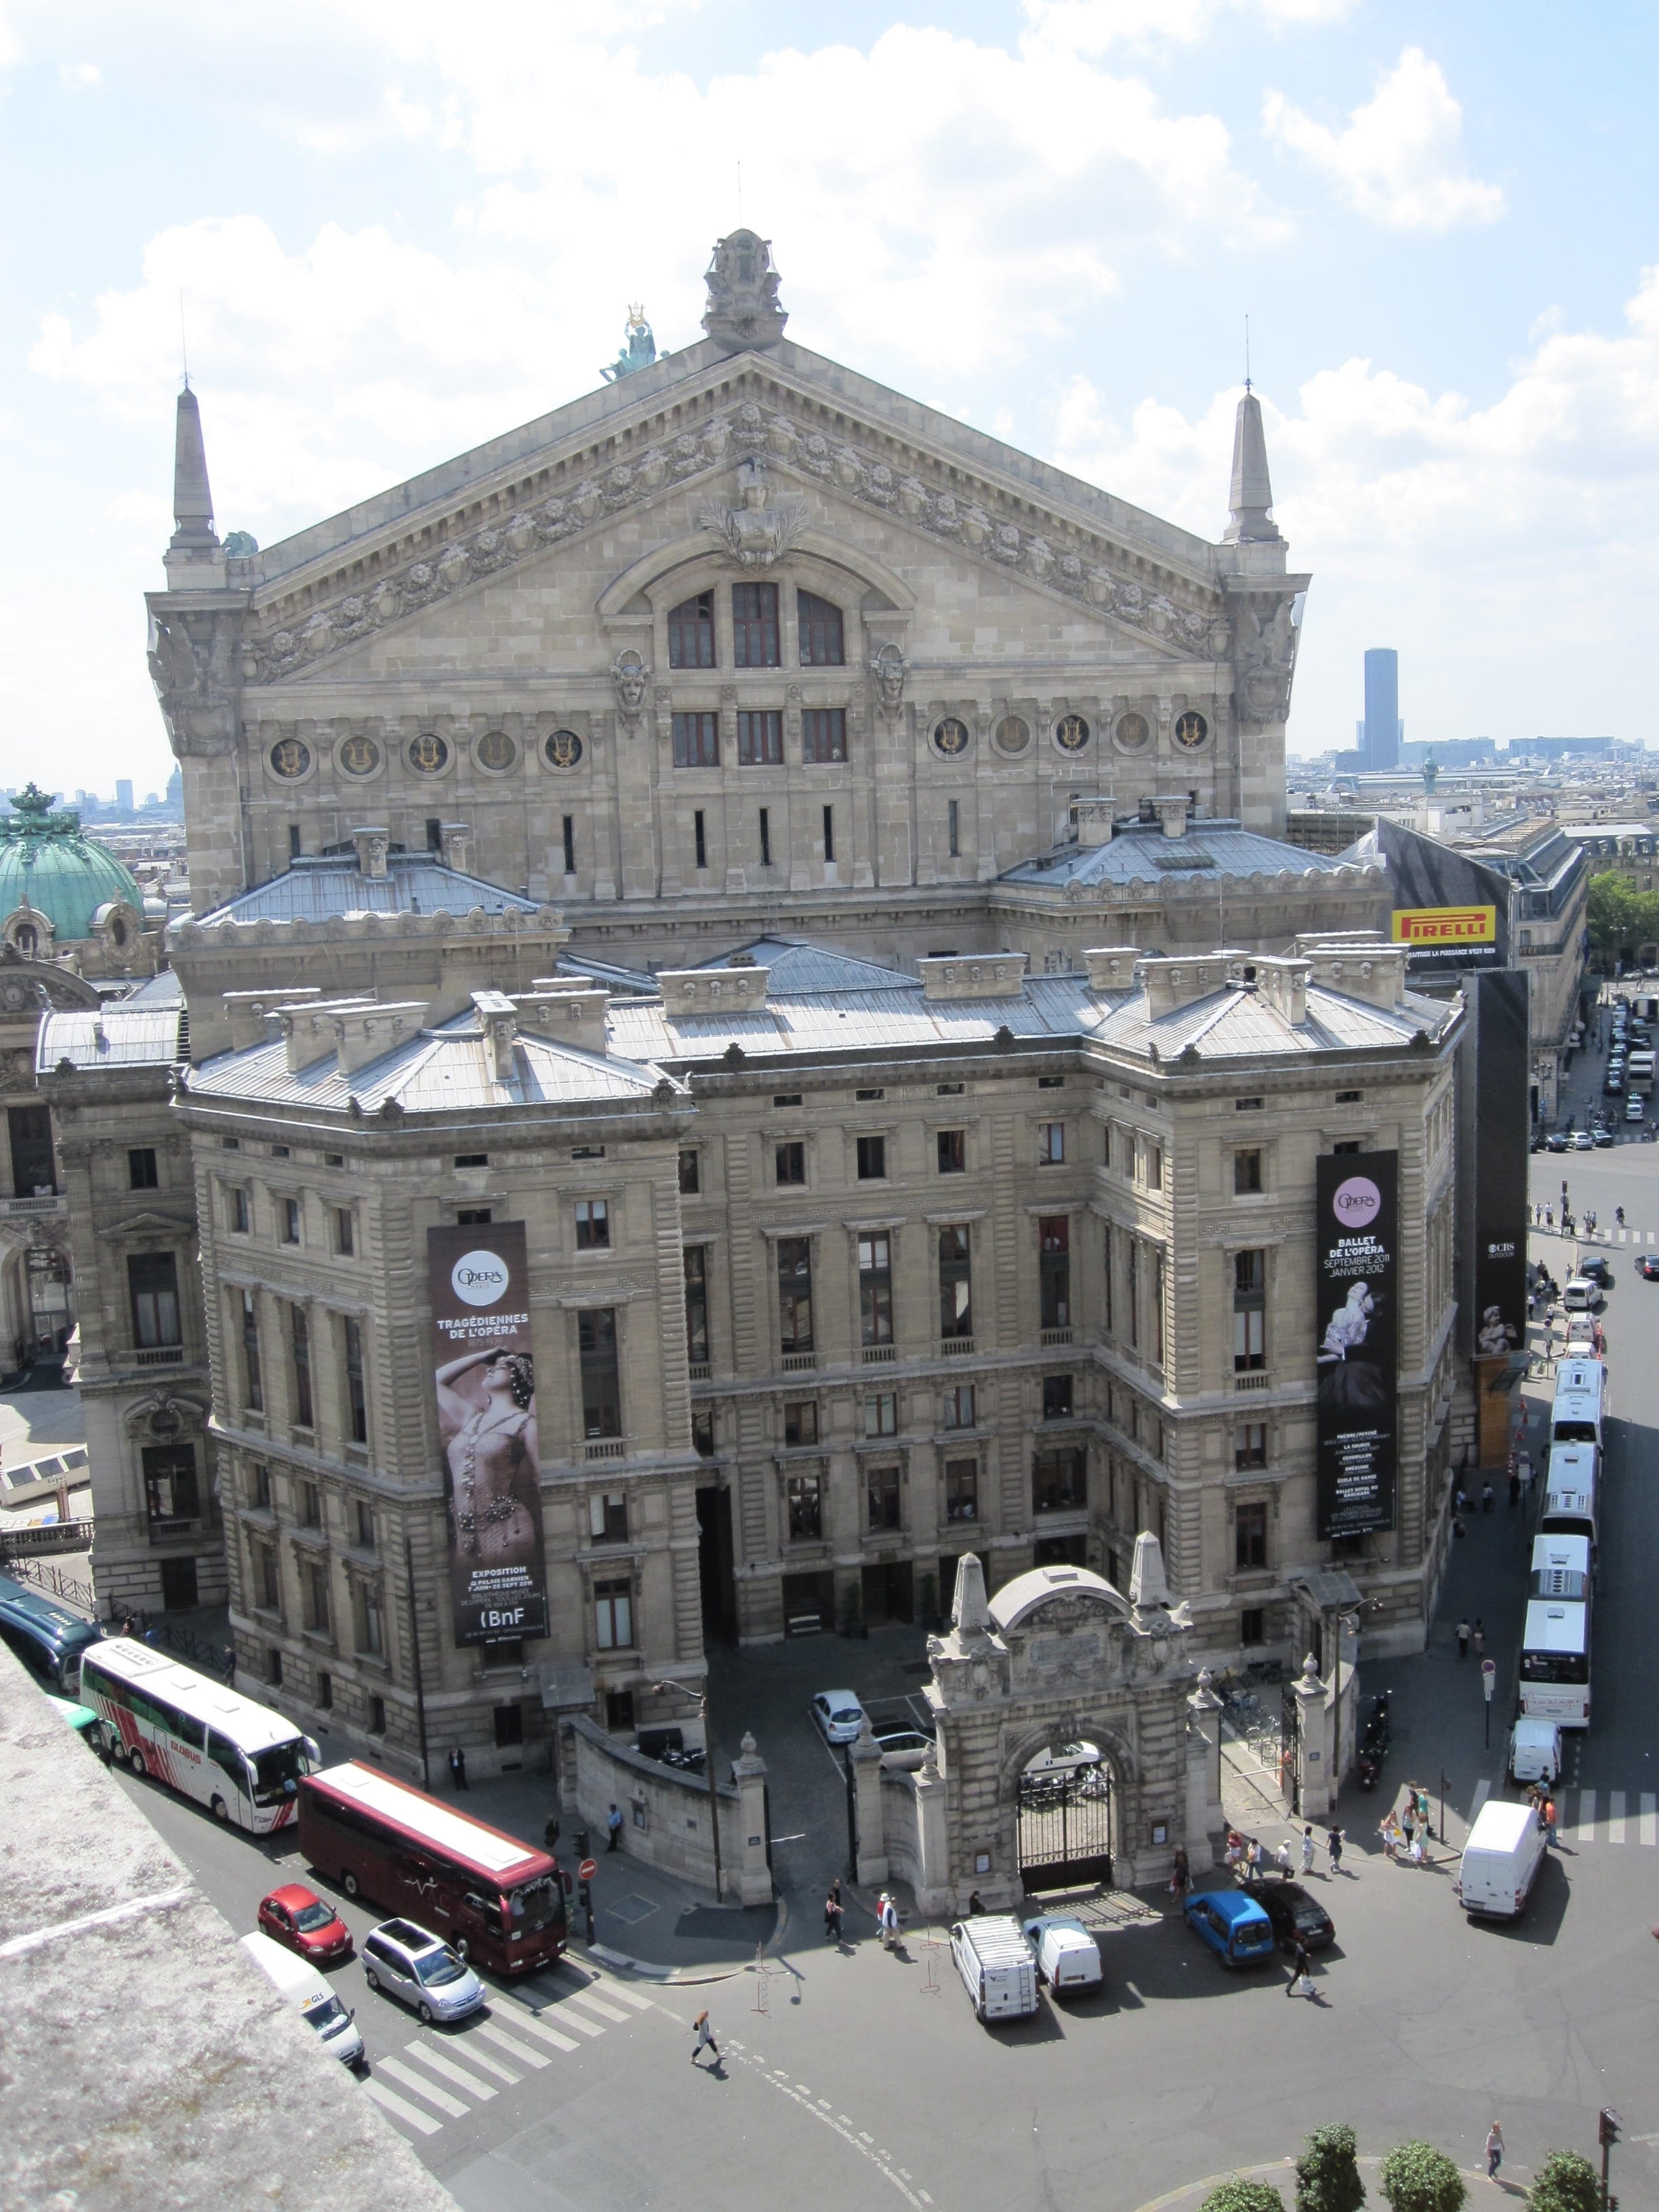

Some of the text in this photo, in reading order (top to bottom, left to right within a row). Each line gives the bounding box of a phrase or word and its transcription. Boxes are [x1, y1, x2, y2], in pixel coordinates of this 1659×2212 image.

[1401, 913, 1487, 938] PIRELLI
[1439, 949, 1468, 957] PUISSANCE
[1338, 1236, 1376, 1248] BALLET
[1497, 1242, 1515, 1252] CBS
[1330, 1244, 1385, 1258] DE L'OPÉRA
[1324, 1254, 1390, 1269] SEPTEMBRE 2011
[1330, 1264, 1385, 1277] JANVIER 2012
[437, 1314, 528, 1329] TRAGÉDIENNES
[450, 1324, 518, 1339] DE L'OPÉRA
[472, 1566, 527, 1578] EXPOSITION
[489, 1608, 524, 1627] BnF
[171, 1740, 201, 1765] GLOBUS
[311, 1992, 324, 2003] GLS
